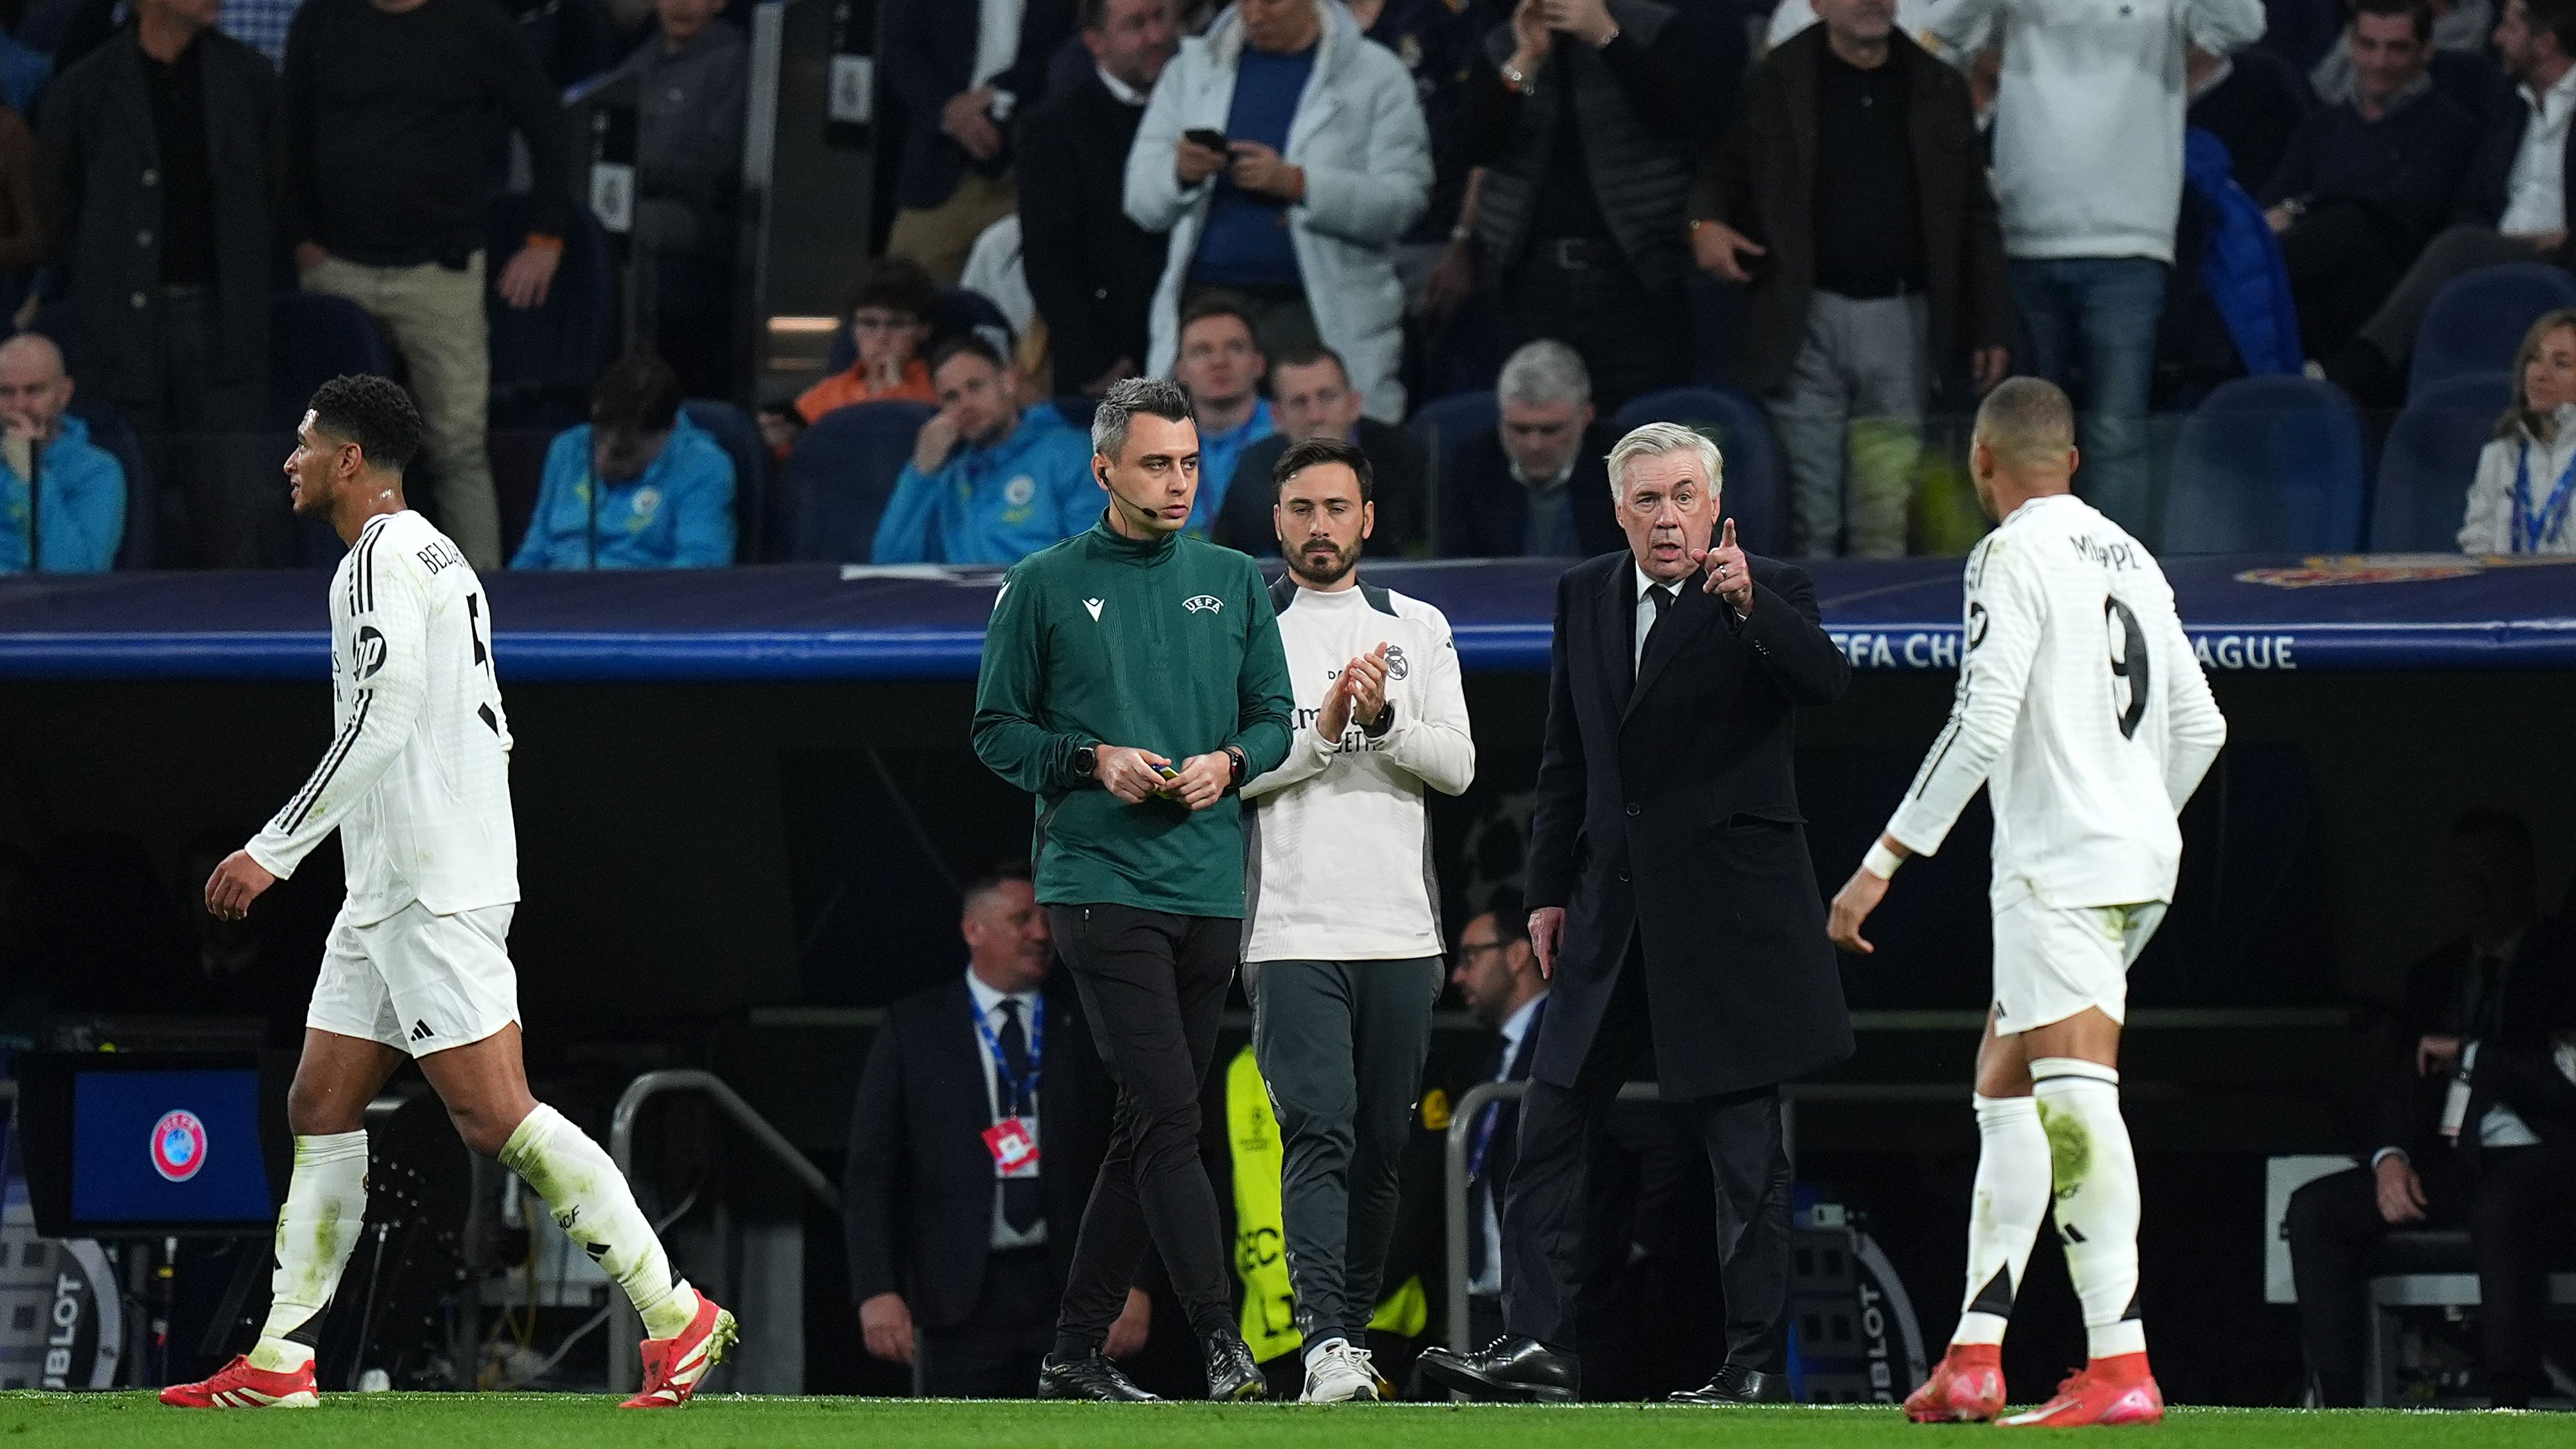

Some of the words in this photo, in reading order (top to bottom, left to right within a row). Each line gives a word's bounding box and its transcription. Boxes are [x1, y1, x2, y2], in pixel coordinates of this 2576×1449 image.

[1185, 597, 1221, 613] UEFA
[2105, 592, 2149, 742] 9
[162, 1115, 196, 1132] UEFA
